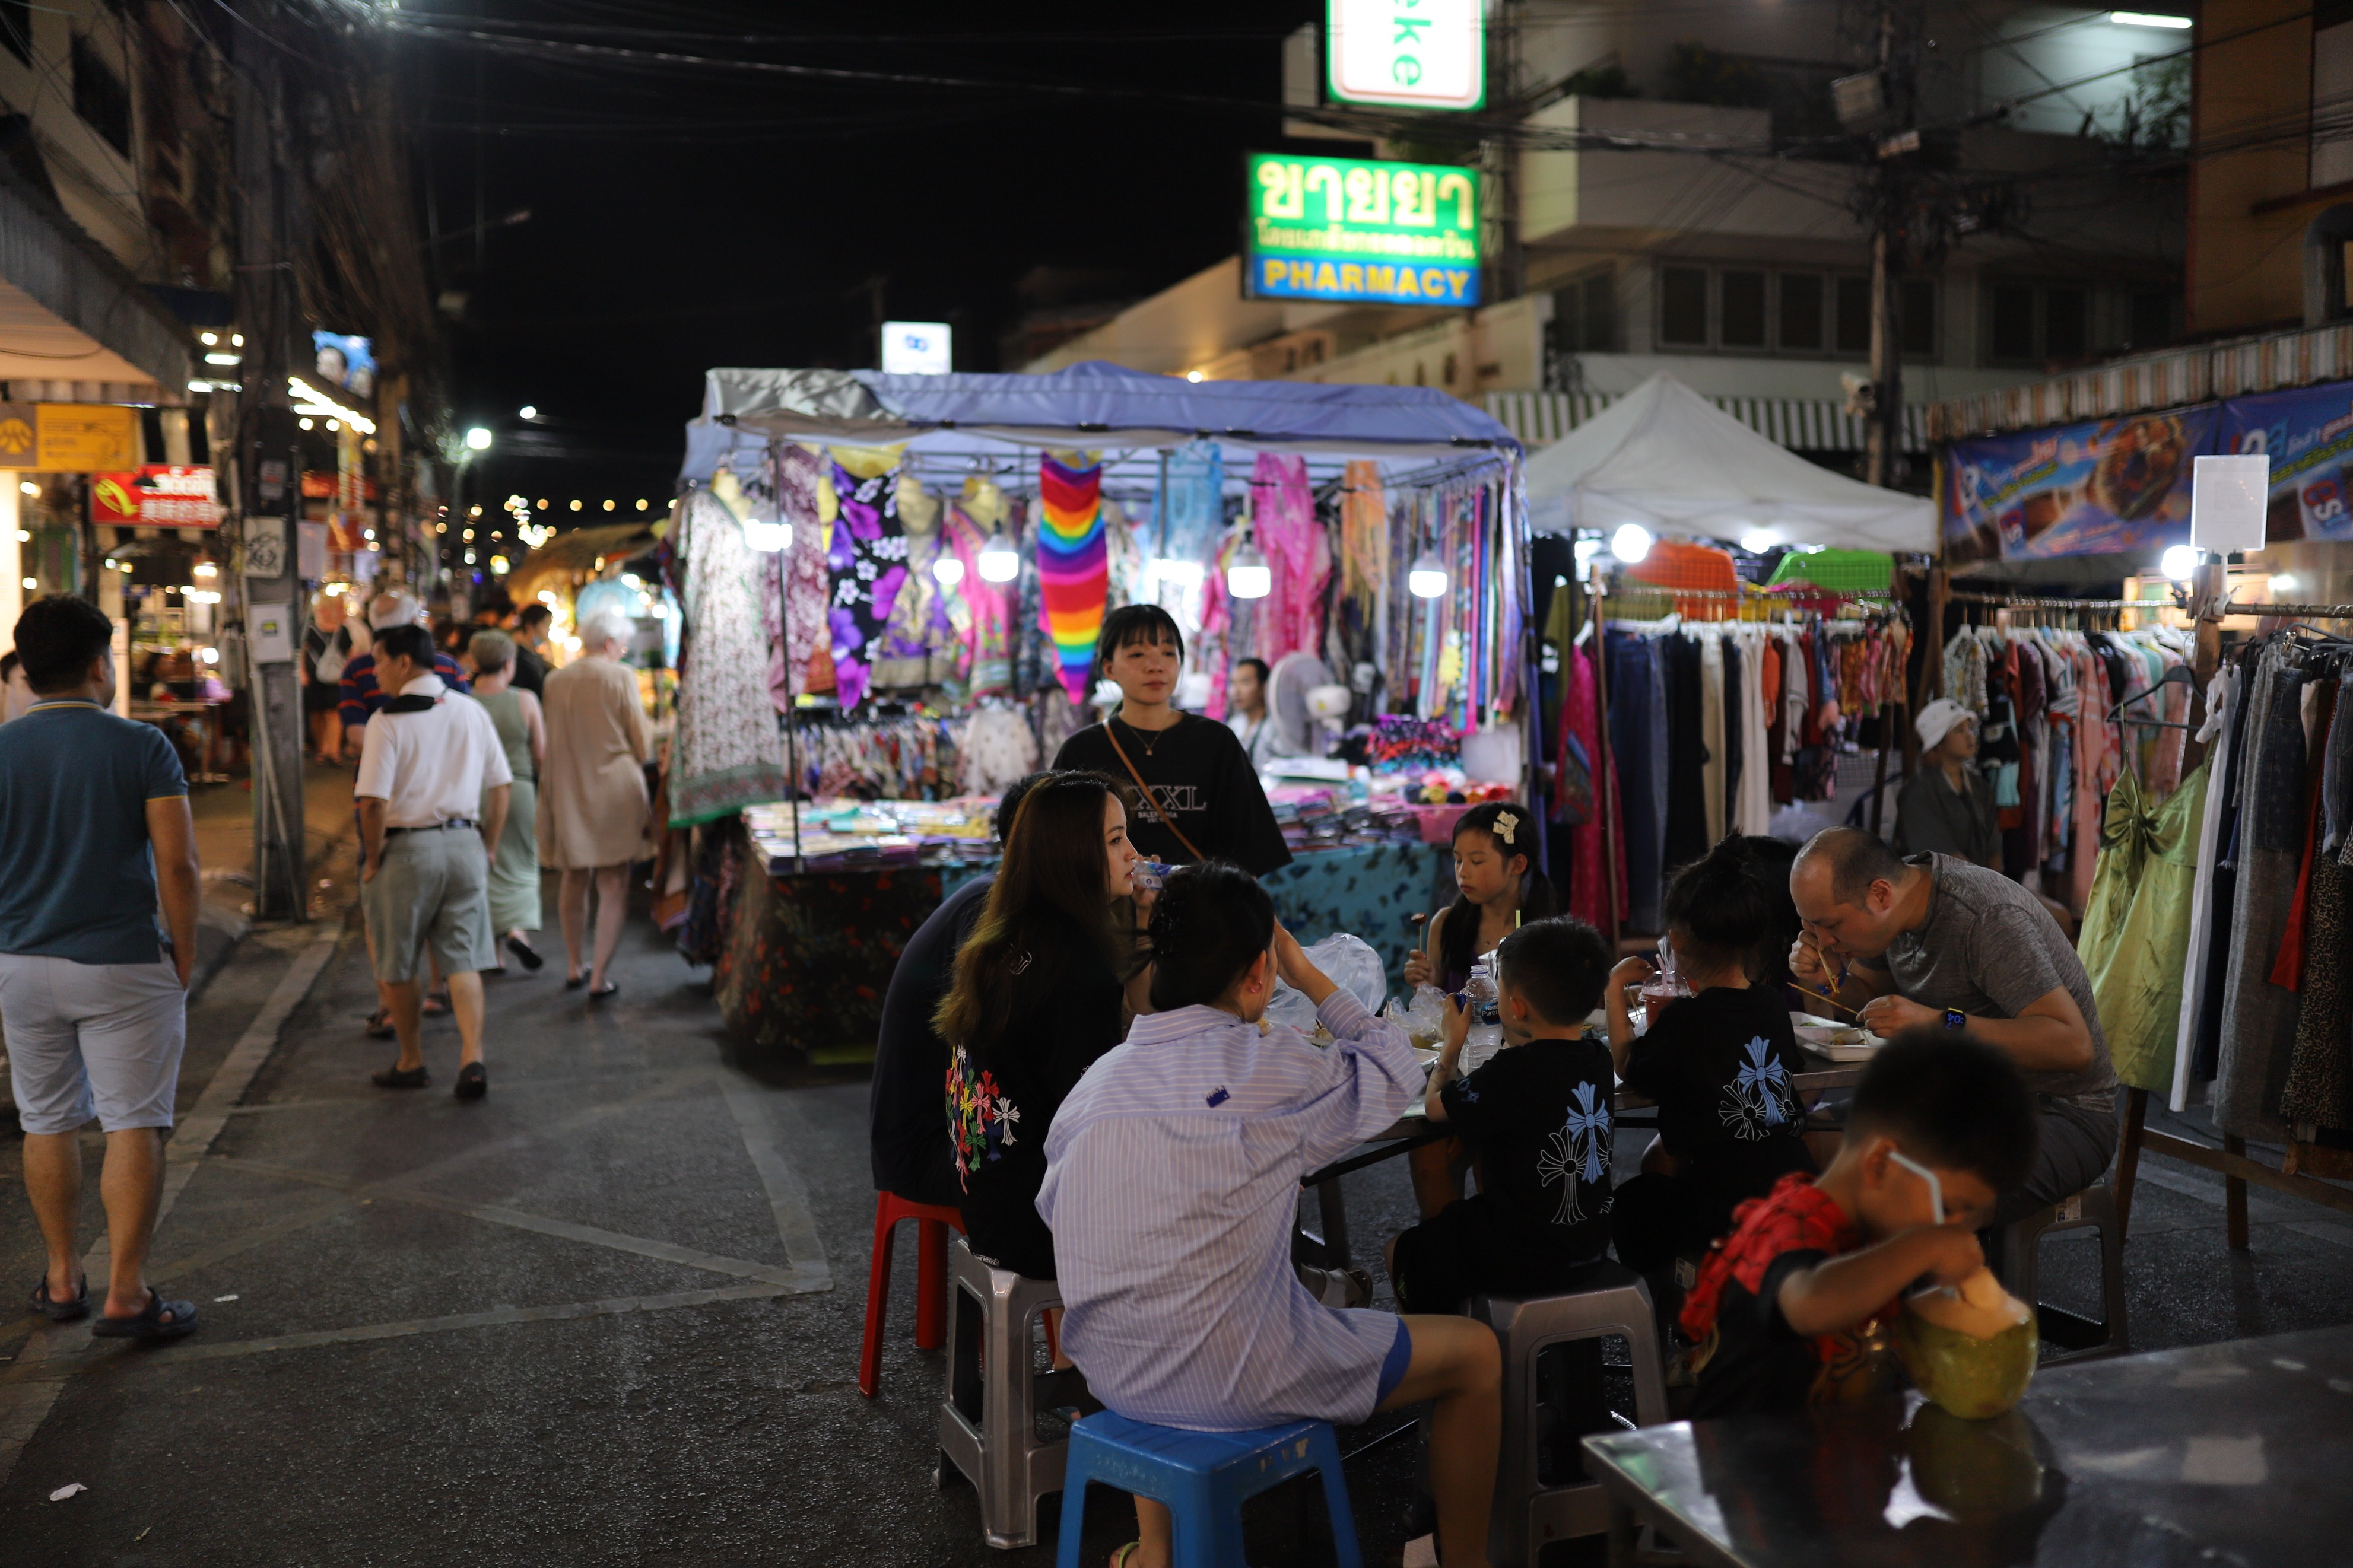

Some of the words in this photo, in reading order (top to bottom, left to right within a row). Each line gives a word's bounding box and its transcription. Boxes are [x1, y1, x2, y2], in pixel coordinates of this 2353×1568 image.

[1392, 0, 1432, 86] ke
[1256, 161, 1475, 230] ขายยา
[1263, 259, 1471, 298] PHARMACY
